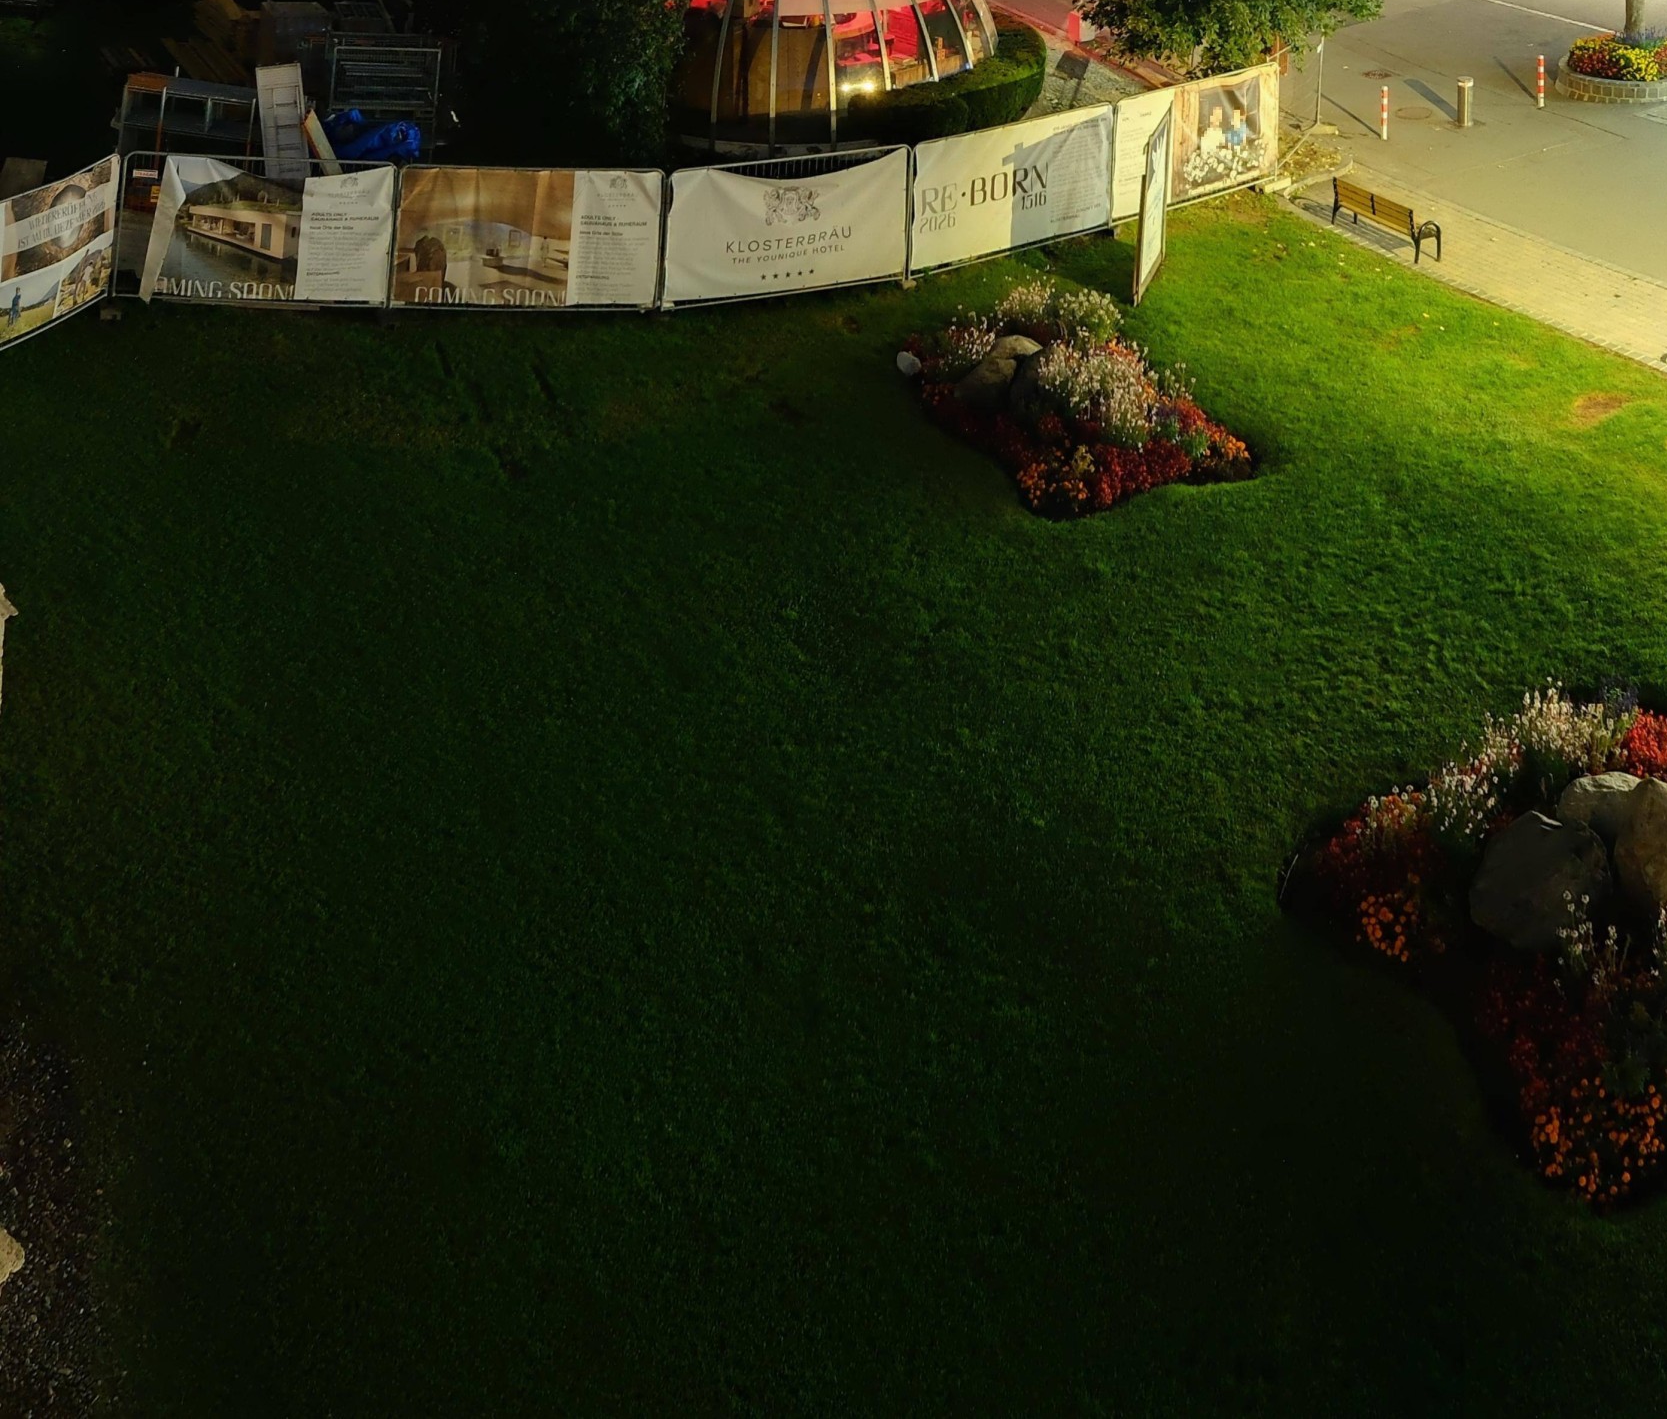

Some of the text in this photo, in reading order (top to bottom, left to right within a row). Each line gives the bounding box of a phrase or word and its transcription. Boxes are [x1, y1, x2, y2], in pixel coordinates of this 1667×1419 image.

[1020, 189, 1048, 211] 1516
[920, 212, 957, 234] 2026
[725, 225, 853, 255] KLOSTERBRÄU
[731, 243, 846, 265] THE YOUNIQUE HOTEL
